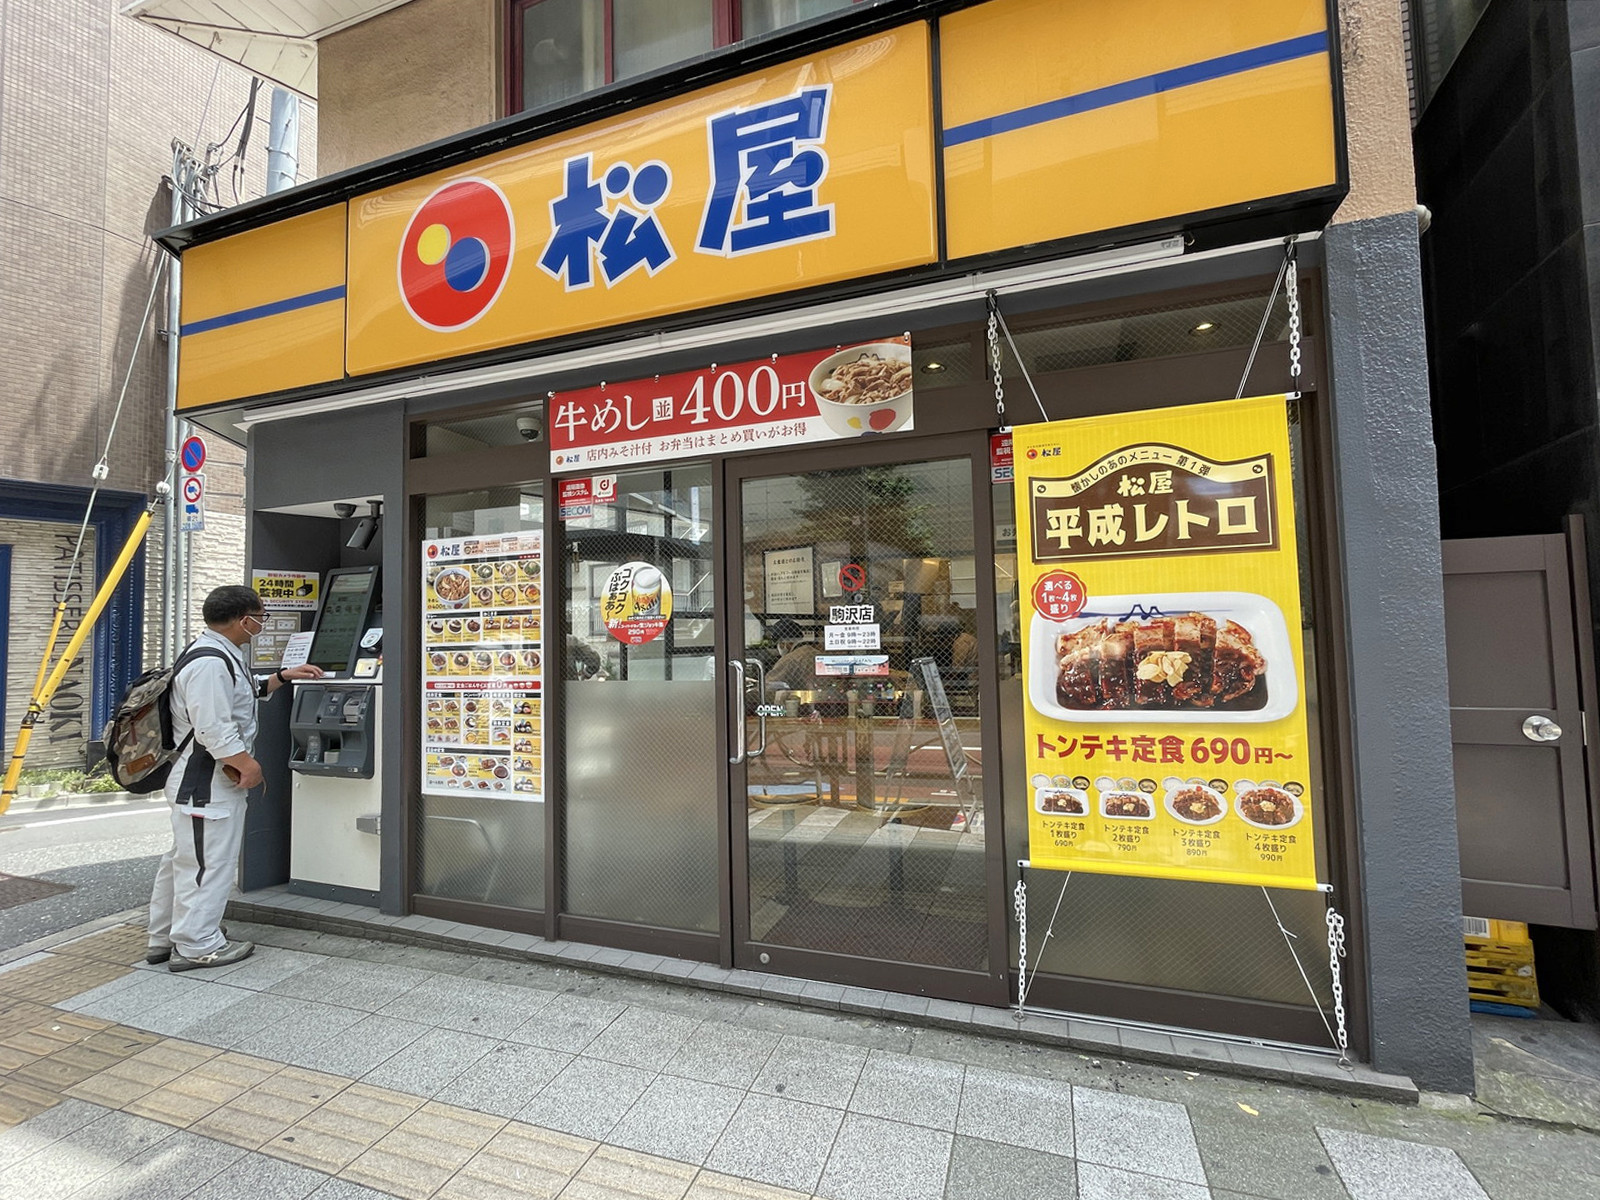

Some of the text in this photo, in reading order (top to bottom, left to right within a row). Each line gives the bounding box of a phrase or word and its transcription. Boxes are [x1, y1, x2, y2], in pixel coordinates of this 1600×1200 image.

[536, 83, 836, 293] 松屋
[554, 366, 805, 441] 牛めし 並 400円
[587, 442, 652, 461] 店内みそ汁付
[659, 422, 806, 451] お弁当はまとめ買いがお得
[1042, 447, 1061, 457] 松屋
[1071, 452, 1211, 492] 懐かしのあのメニュー 第1弾
[1117, 470, 1174, 497] 松屋
[561, 506, 590, 516] SECOM
[1046, 496, 1258, 550] 平成レトロ
[440, 544, 460, 556] 松屋
[259, 579, 294, 588] 24時間
[1044, 580, 1072, 591] 選べる
[259, 588, 293, 598] 監視中
[615, 567, 633, 615] ゴクゴク
[831, 606, 872, 622] 駒沢店
[757, 705, 784, 716] OPEN
[1042, 820, 1085, 830] トンテキ定食
[1104, 824, 1149, 834] トンテキ定食
[1050, 830, 1077, 838] 1枚盛り
[1112, 834, 1140, 843] 2枚盛り
[1173, 828, 1221, 839] トンテキ定食
[1246, 833, 1296, 844] トンテキ定食
[1182, 838, 1211, 847] 3枚盛り
[1255, 843, 1287, 853] 4枚盛り
